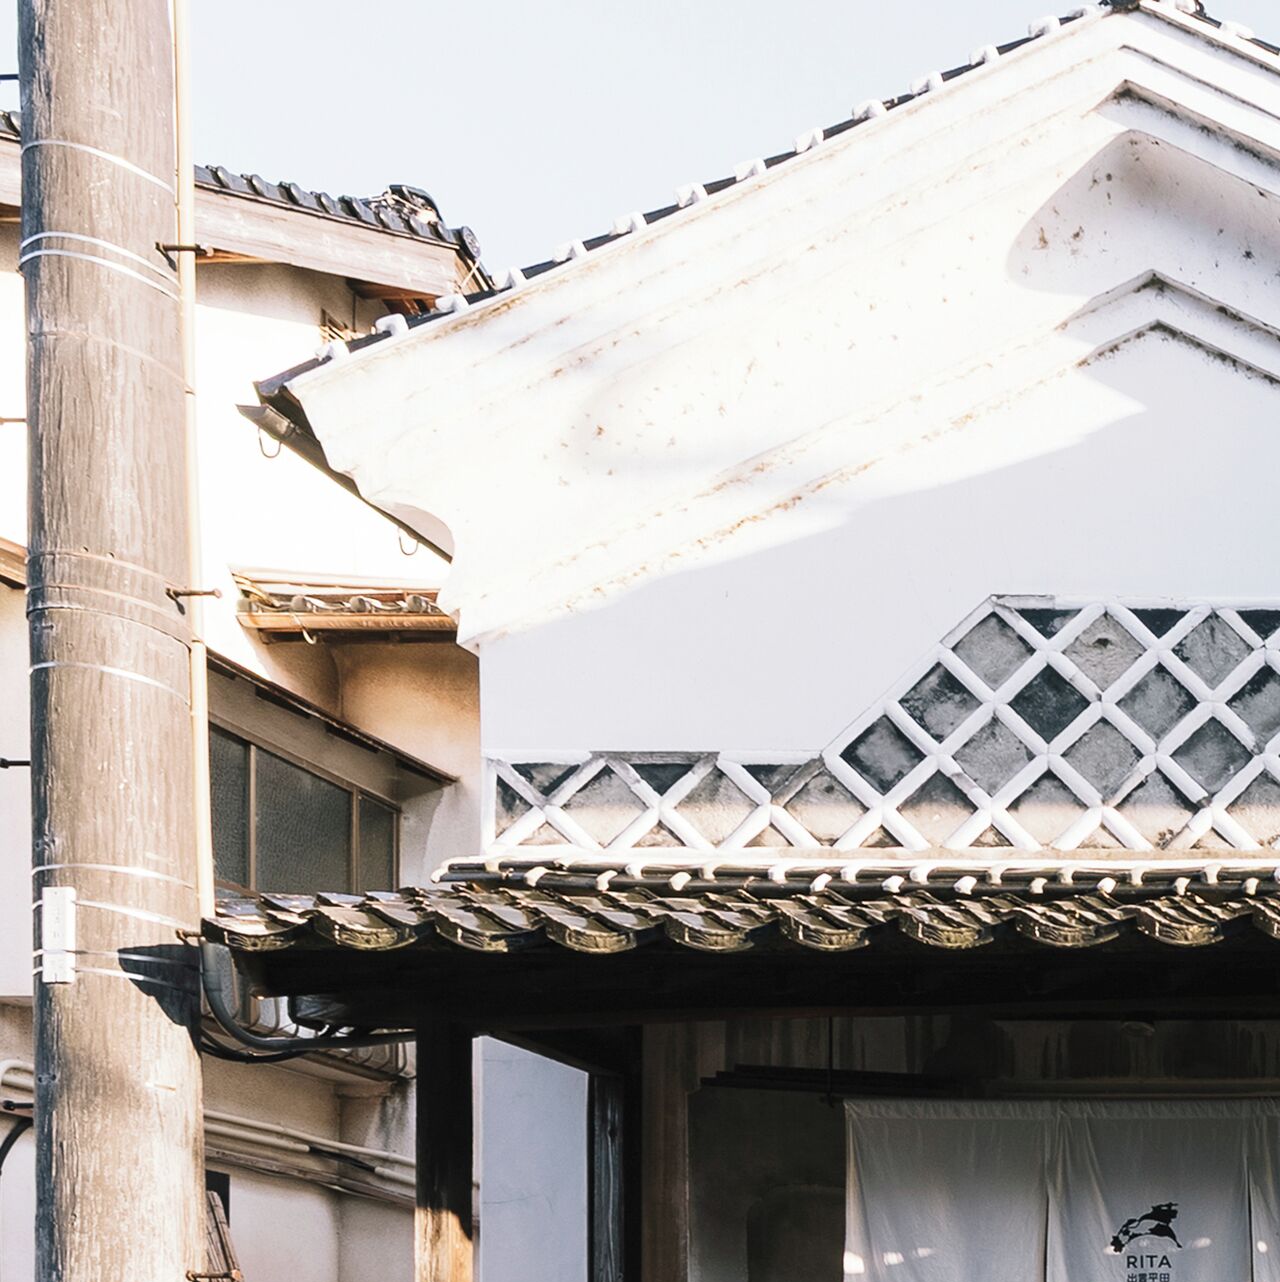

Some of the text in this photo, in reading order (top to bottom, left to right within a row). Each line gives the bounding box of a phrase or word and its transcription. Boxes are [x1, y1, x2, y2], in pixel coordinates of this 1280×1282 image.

[1126, 1255, 1172, 1269] RITA
[1127, 1273, 1170, 1282] 出雲平田
